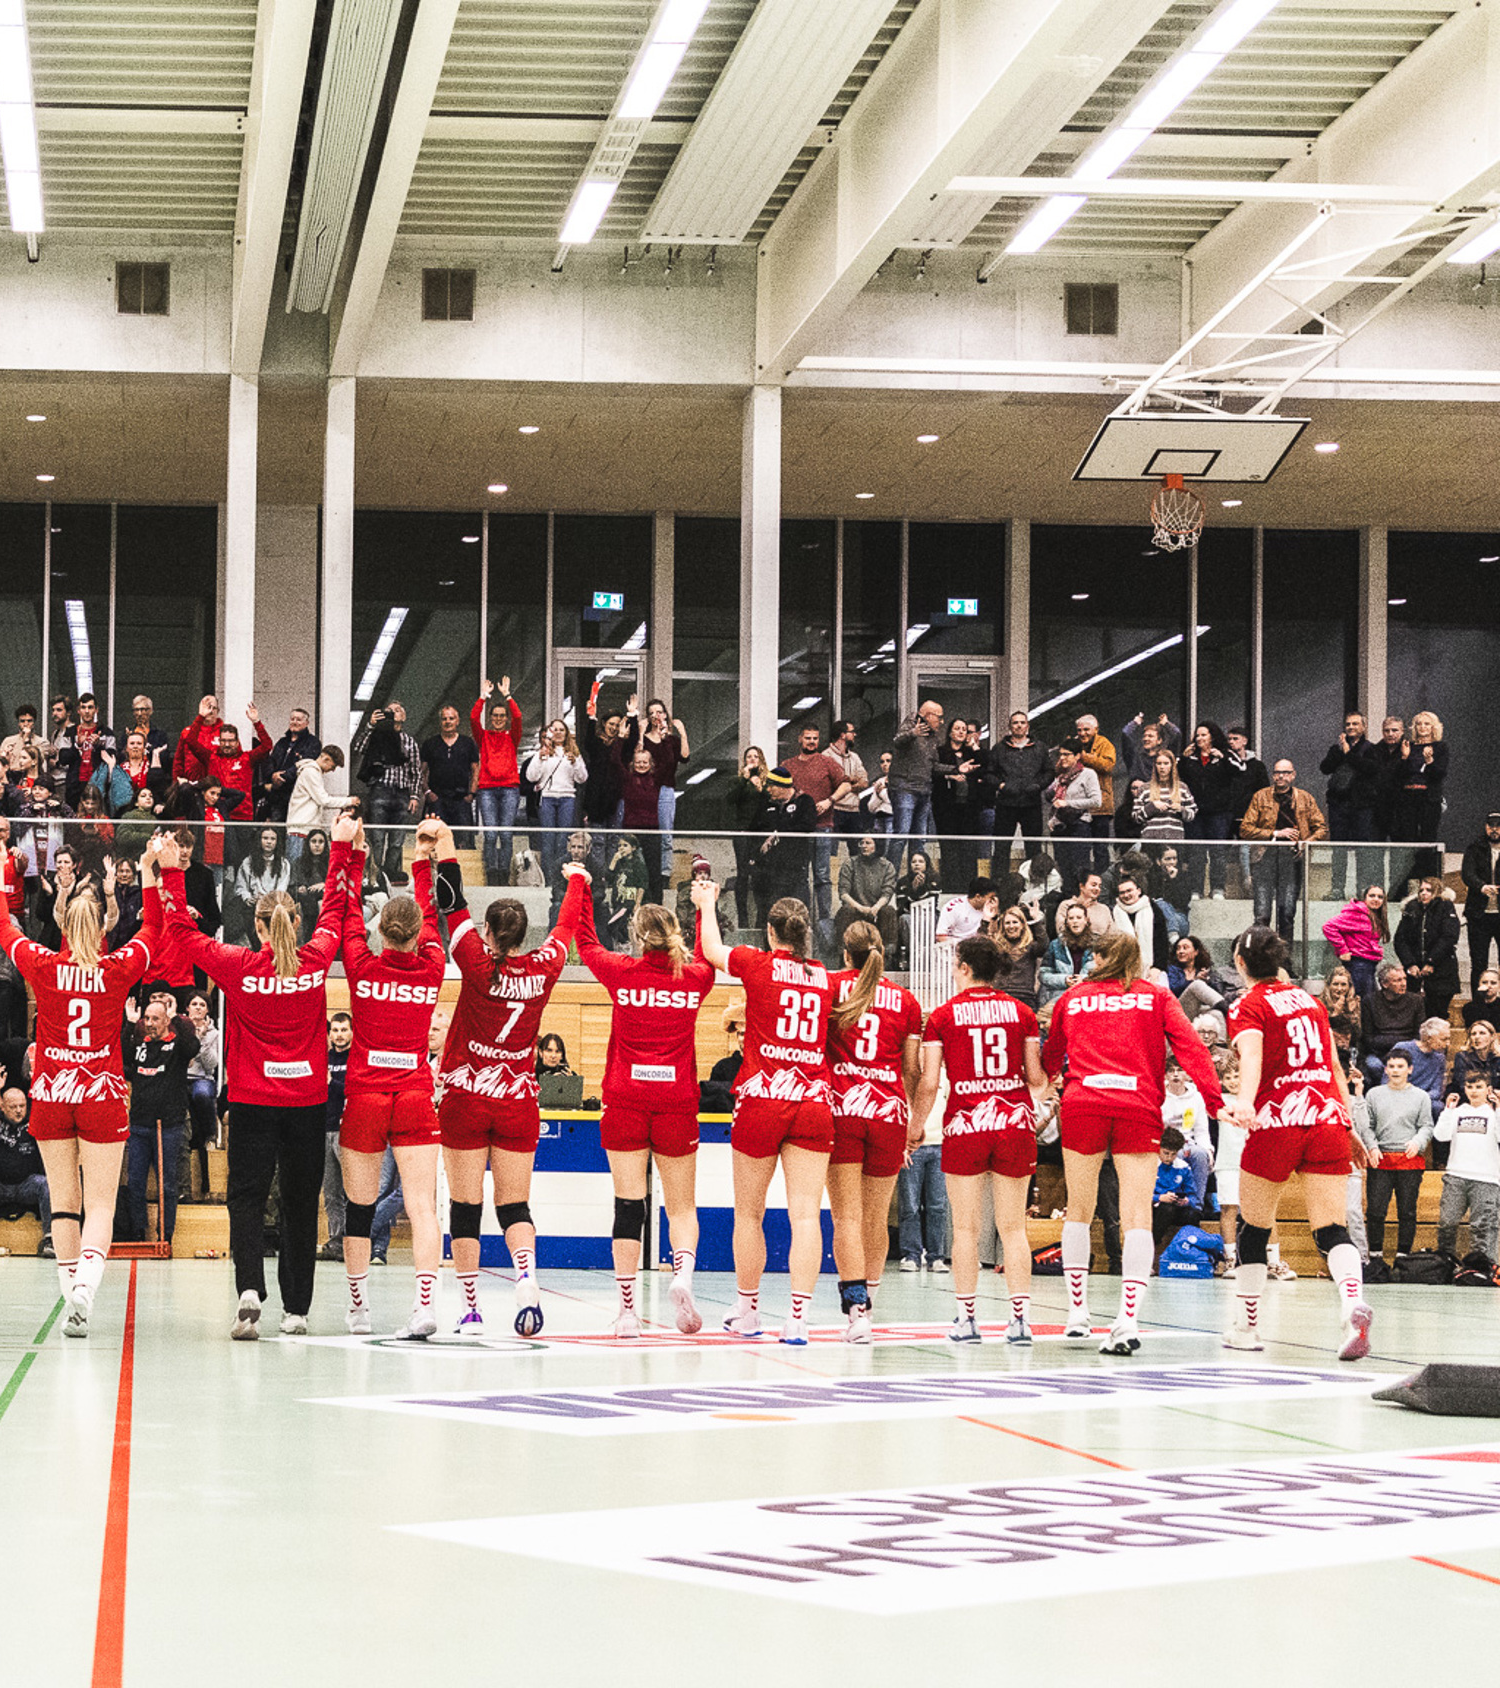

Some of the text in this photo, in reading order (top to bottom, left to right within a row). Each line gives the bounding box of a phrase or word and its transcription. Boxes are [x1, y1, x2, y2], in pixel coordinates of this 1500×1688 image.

[57, 964, 106, 992] WICK
[241, 969, 325, 994] SUISSE
[356, 979, 438, 1004] SUISSE
[839, 977, 901, 1013] KDIG
[617, 987, 700, 1010] SUISSE
[776, 989, 821, 1043] 33
[952, 1000, 1019, 1026] BAUMANN
[1067, 993, 1154, 1014] SUISSE
[67, 998, 91, 1047] 2
[495, 1002, 525, 1043] 7
[855, 1012, 880, 1061] 3
[968, 1027, 1008, 1077] 13
[1286, 1016, 1323, 1068] 34
[954, 1074, 1025, 1095] CONCORDIA
[757, 1462, 1443, 1526] MOTORS
[645, 1482, 1500, 1583] ITSUBISHI
